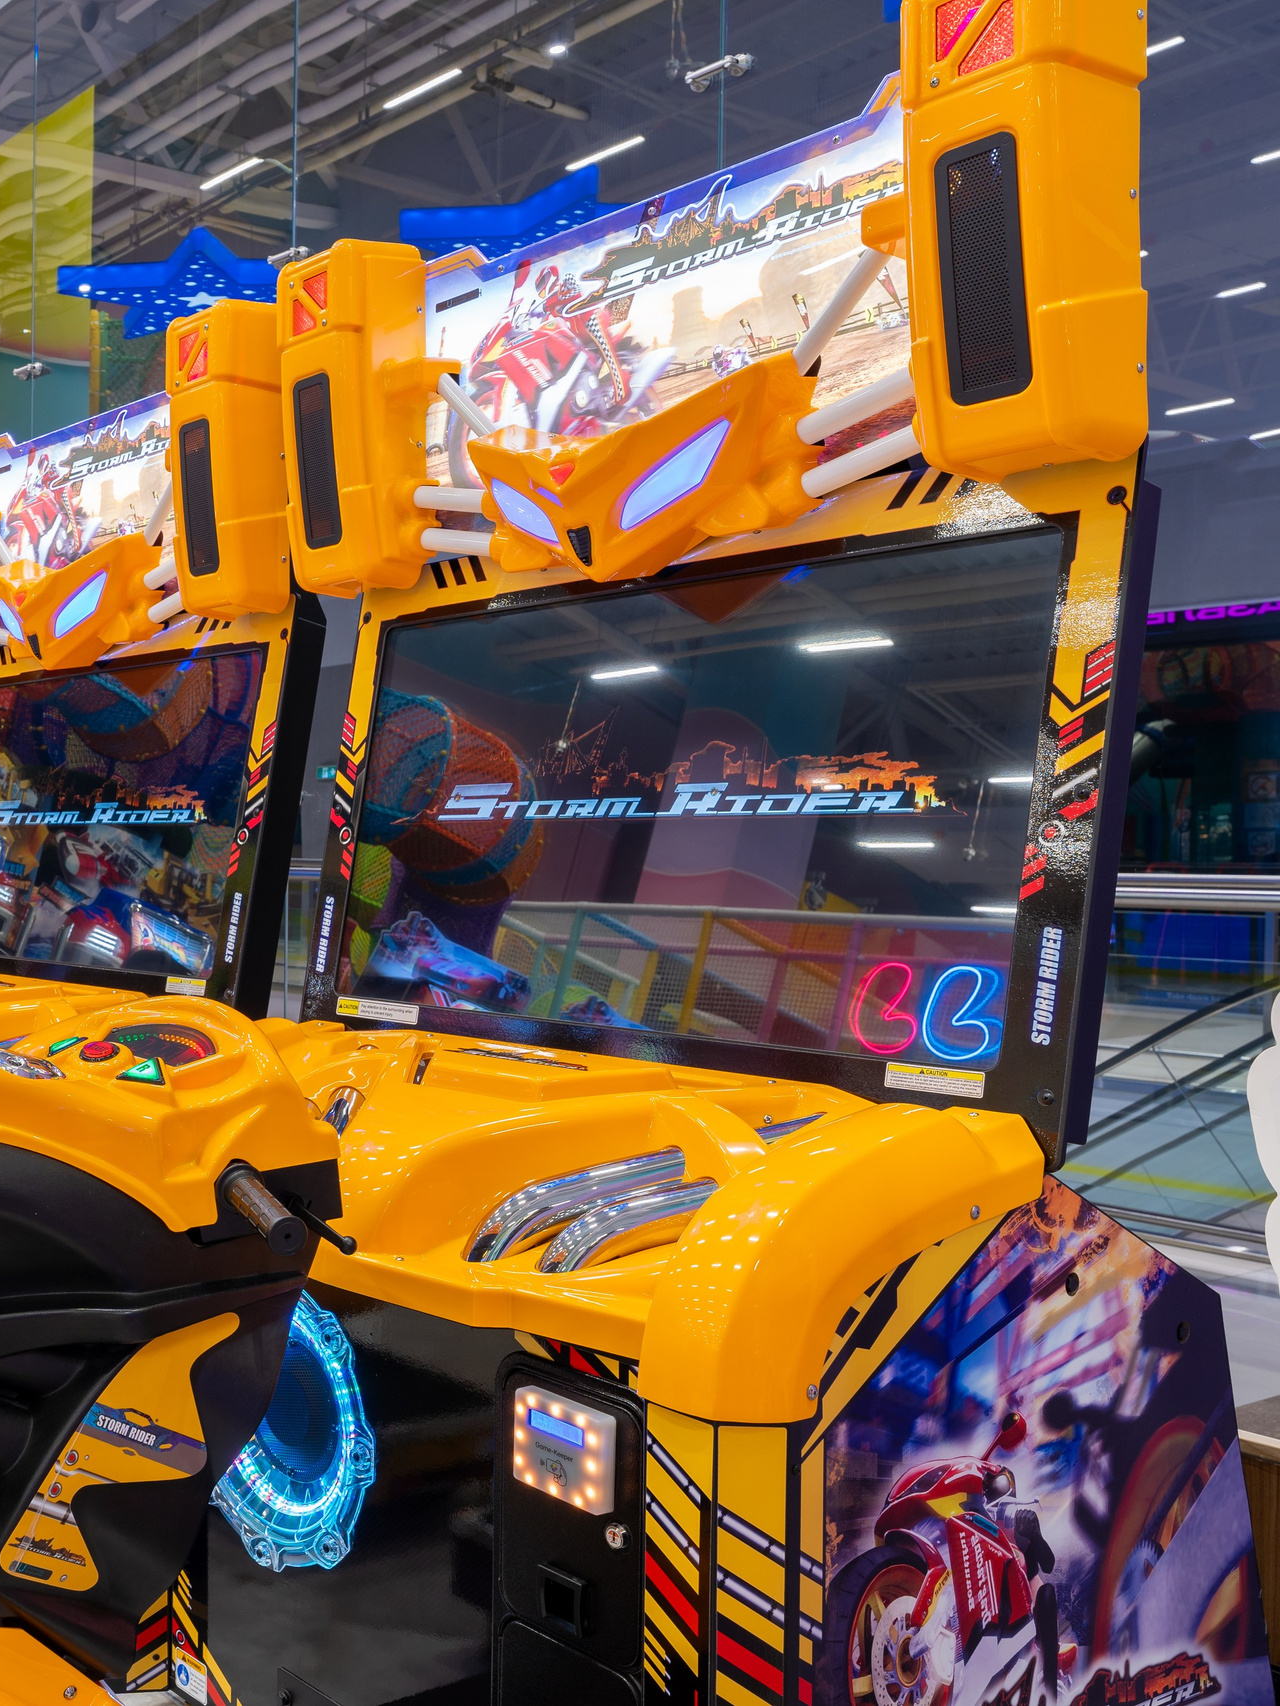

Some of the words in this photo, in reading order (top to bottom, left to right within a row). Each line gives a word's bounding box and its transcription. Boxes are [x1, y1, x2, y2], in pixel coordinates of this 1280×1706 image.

[603, 238, 756, 297] STORM
[69, 450, 135, 480] STORM
[90, 801, 197, 825] RIDER
[437, 782, 652, 821] STORM
[654, 782, 922, 817] RIDER
[224, 925, 237, 963] STORM
[231, 892, 243, 925] RIDER
[321, 896, 335, 937] STORM
[316, 938, 329, 973] RIDER
[1038, 926, 1062, 980] RIDER
[1031, 981, 1056, 1045] STORM
[925, 1069, 949, 1077] CAUTION
[96, 1415, 128, 1439] STORM
[128, 1427, 156, 1446] RIDER
[535, 1441, 573, 1463] Game-Keeper
